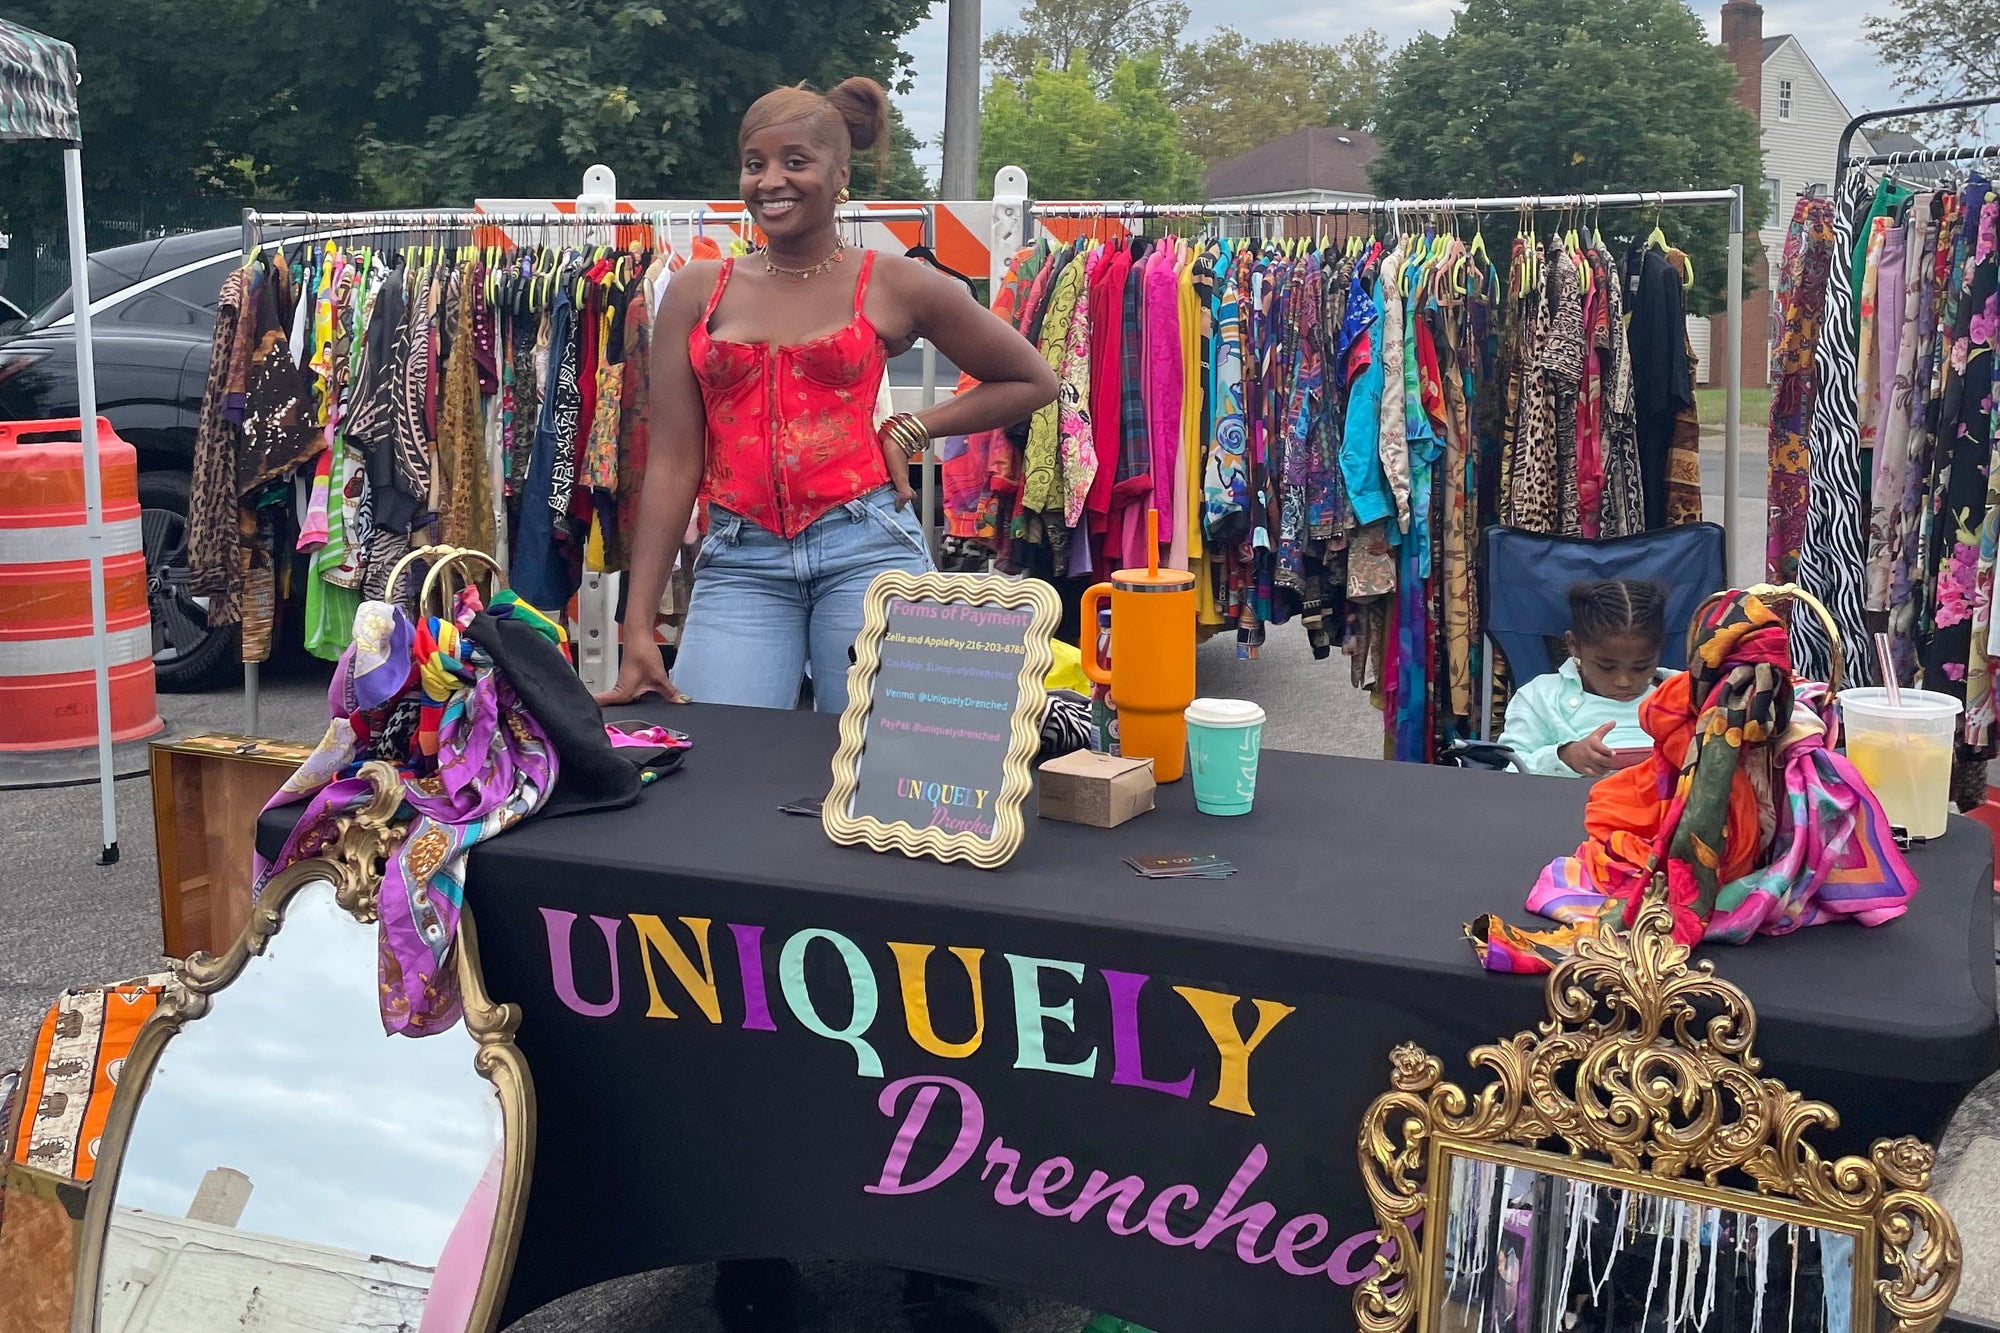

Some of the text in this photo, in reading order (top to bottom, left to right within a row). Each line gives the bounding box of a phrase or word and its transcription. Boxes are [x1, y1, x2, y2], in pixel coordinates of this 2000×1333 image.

[892, 600, 1029, 627] Forms of Payment
[885, 632, 906, 643] Zelle
[907, 635, 924, 645] and
[924, 636, 965, 650] ApplePay
[885, 658, 924, 672] CashApp:
[885, 688, 1008, 711] Venmo: @UniquelyDrenched
[912, 722, 1000, 742] @uniquelydrenched
[897, 777, 989, 809] UNIQUELY
[538, 906, 1297, 1117] UNIQUELY
